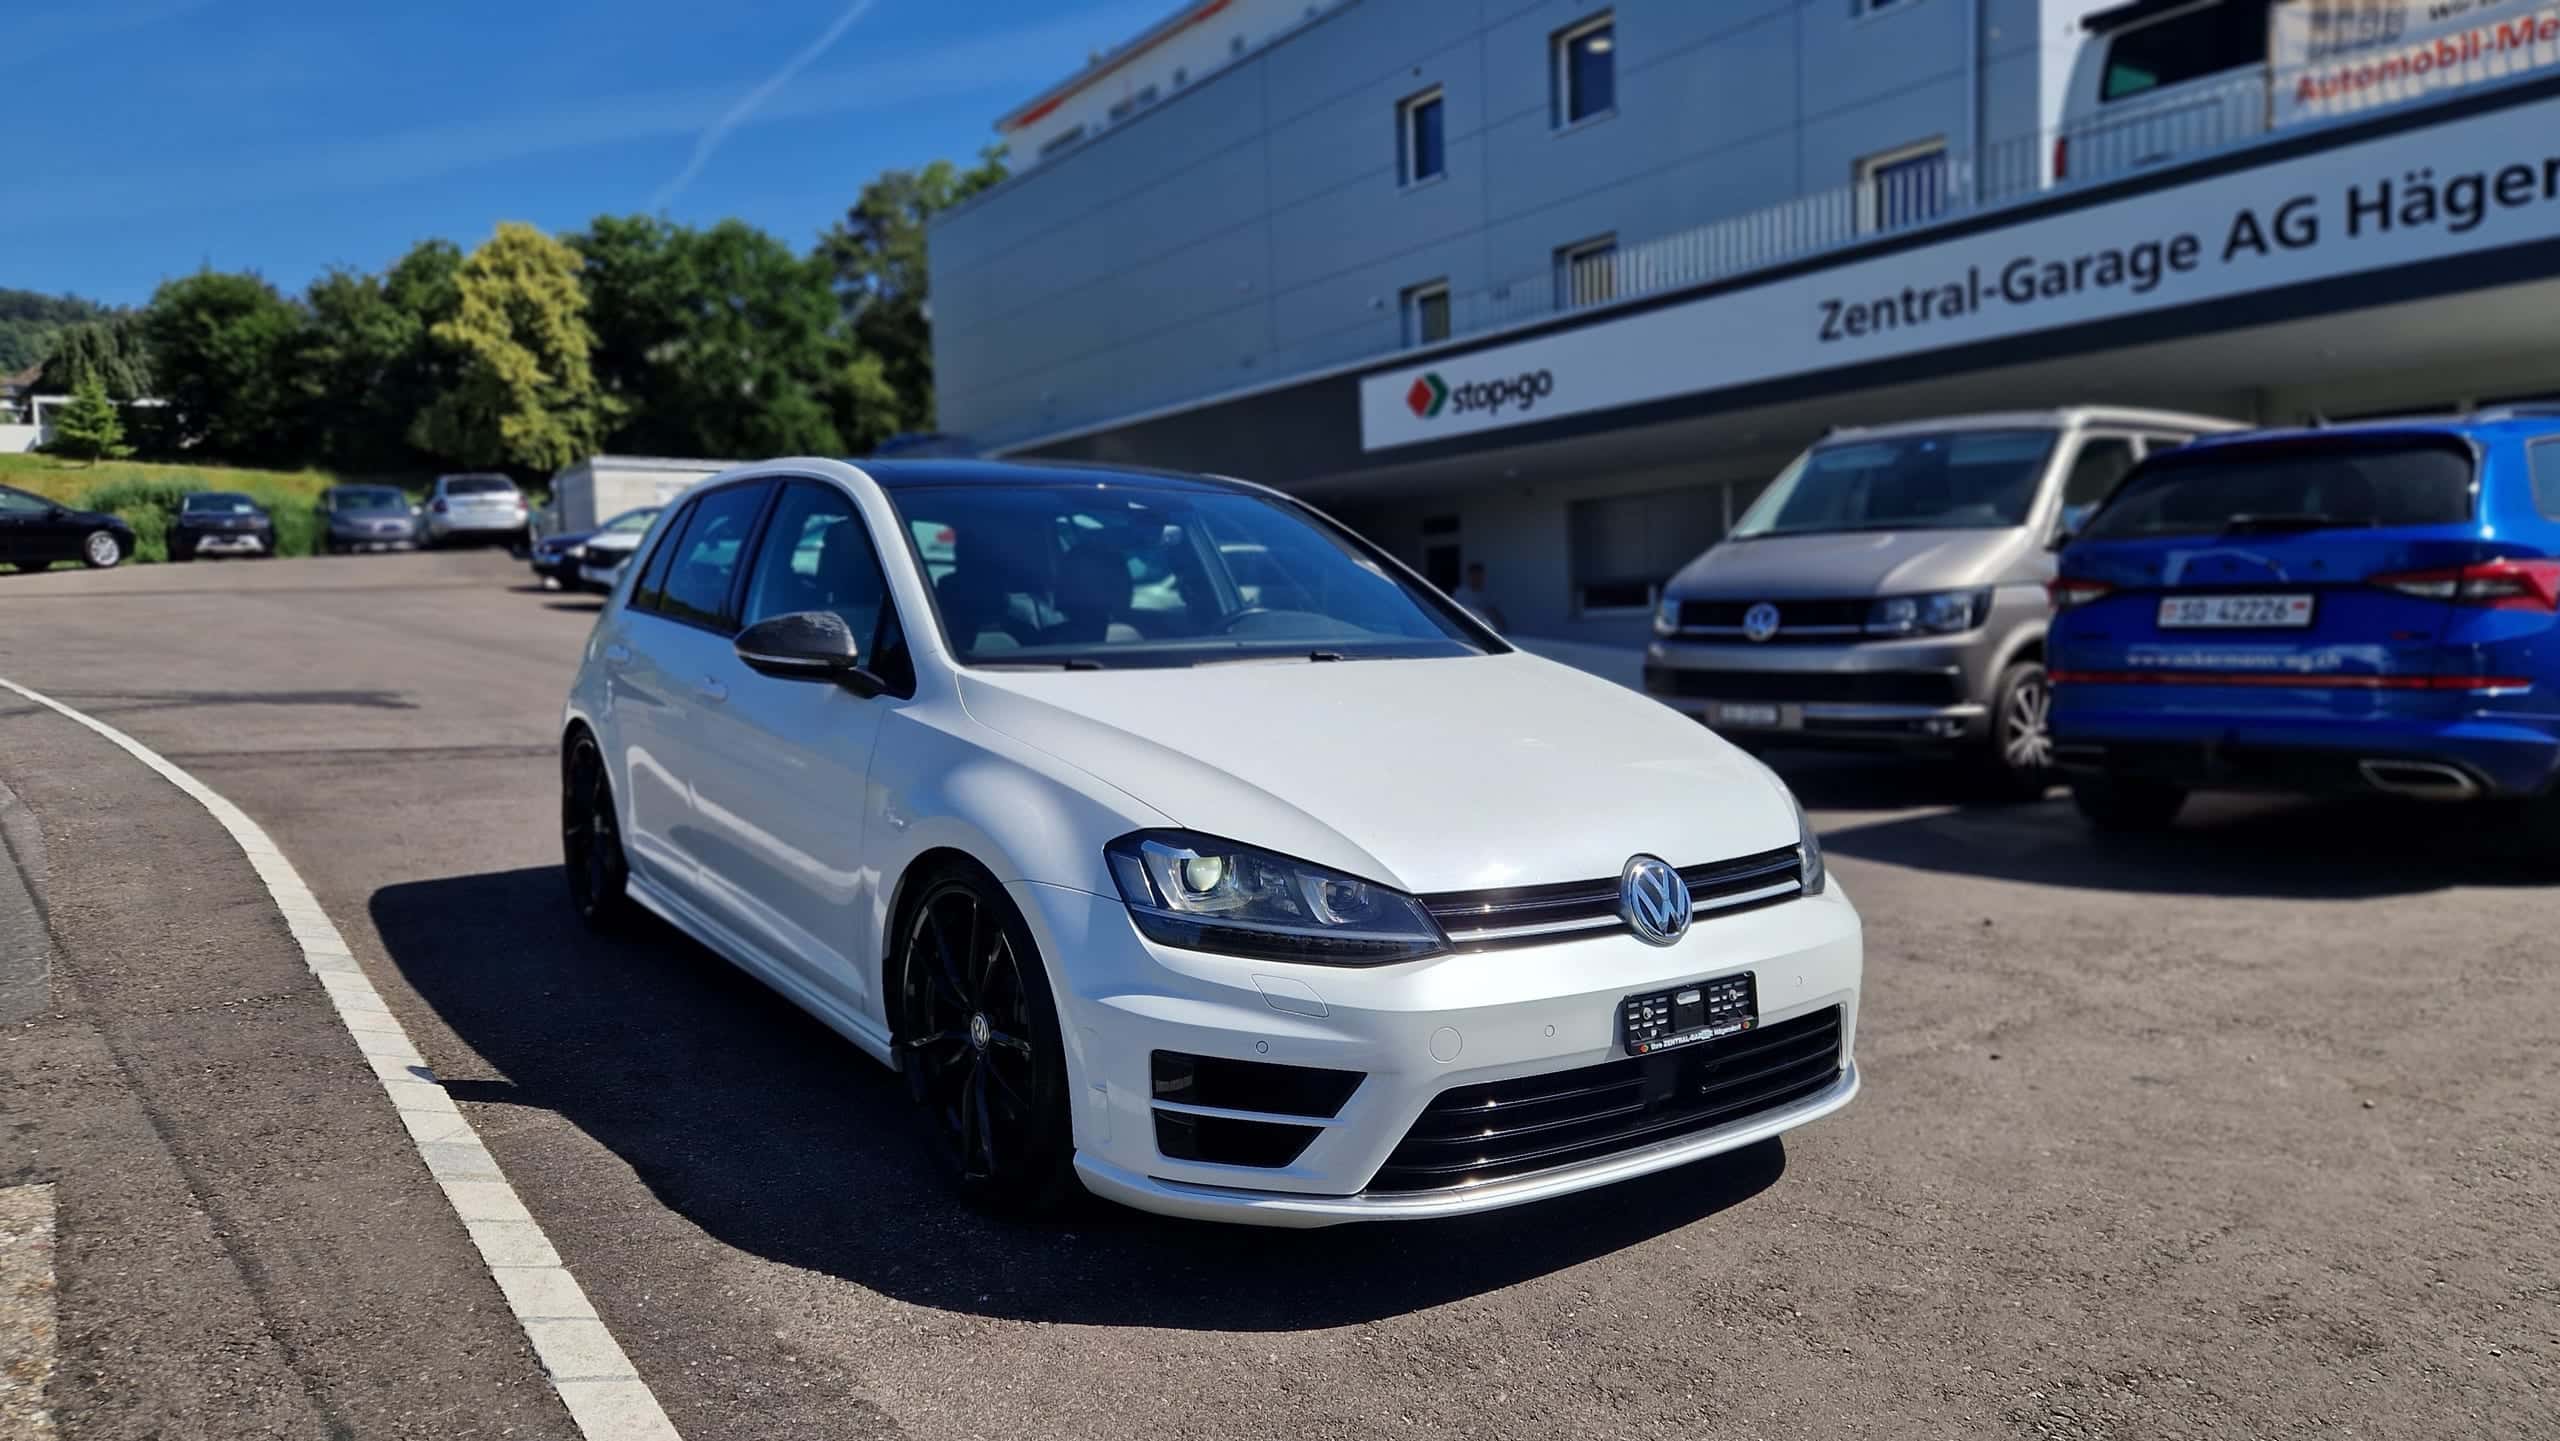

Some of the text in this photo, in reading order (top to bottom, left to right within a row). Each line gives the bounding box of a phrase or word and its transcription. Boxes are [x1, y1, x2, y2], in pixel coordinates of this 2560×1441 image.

[1819, 233, 2201, 341] Zentral-Garage
[2222, 195, 2319, 262] AG
[1629, 860, 1692, 938] VW
